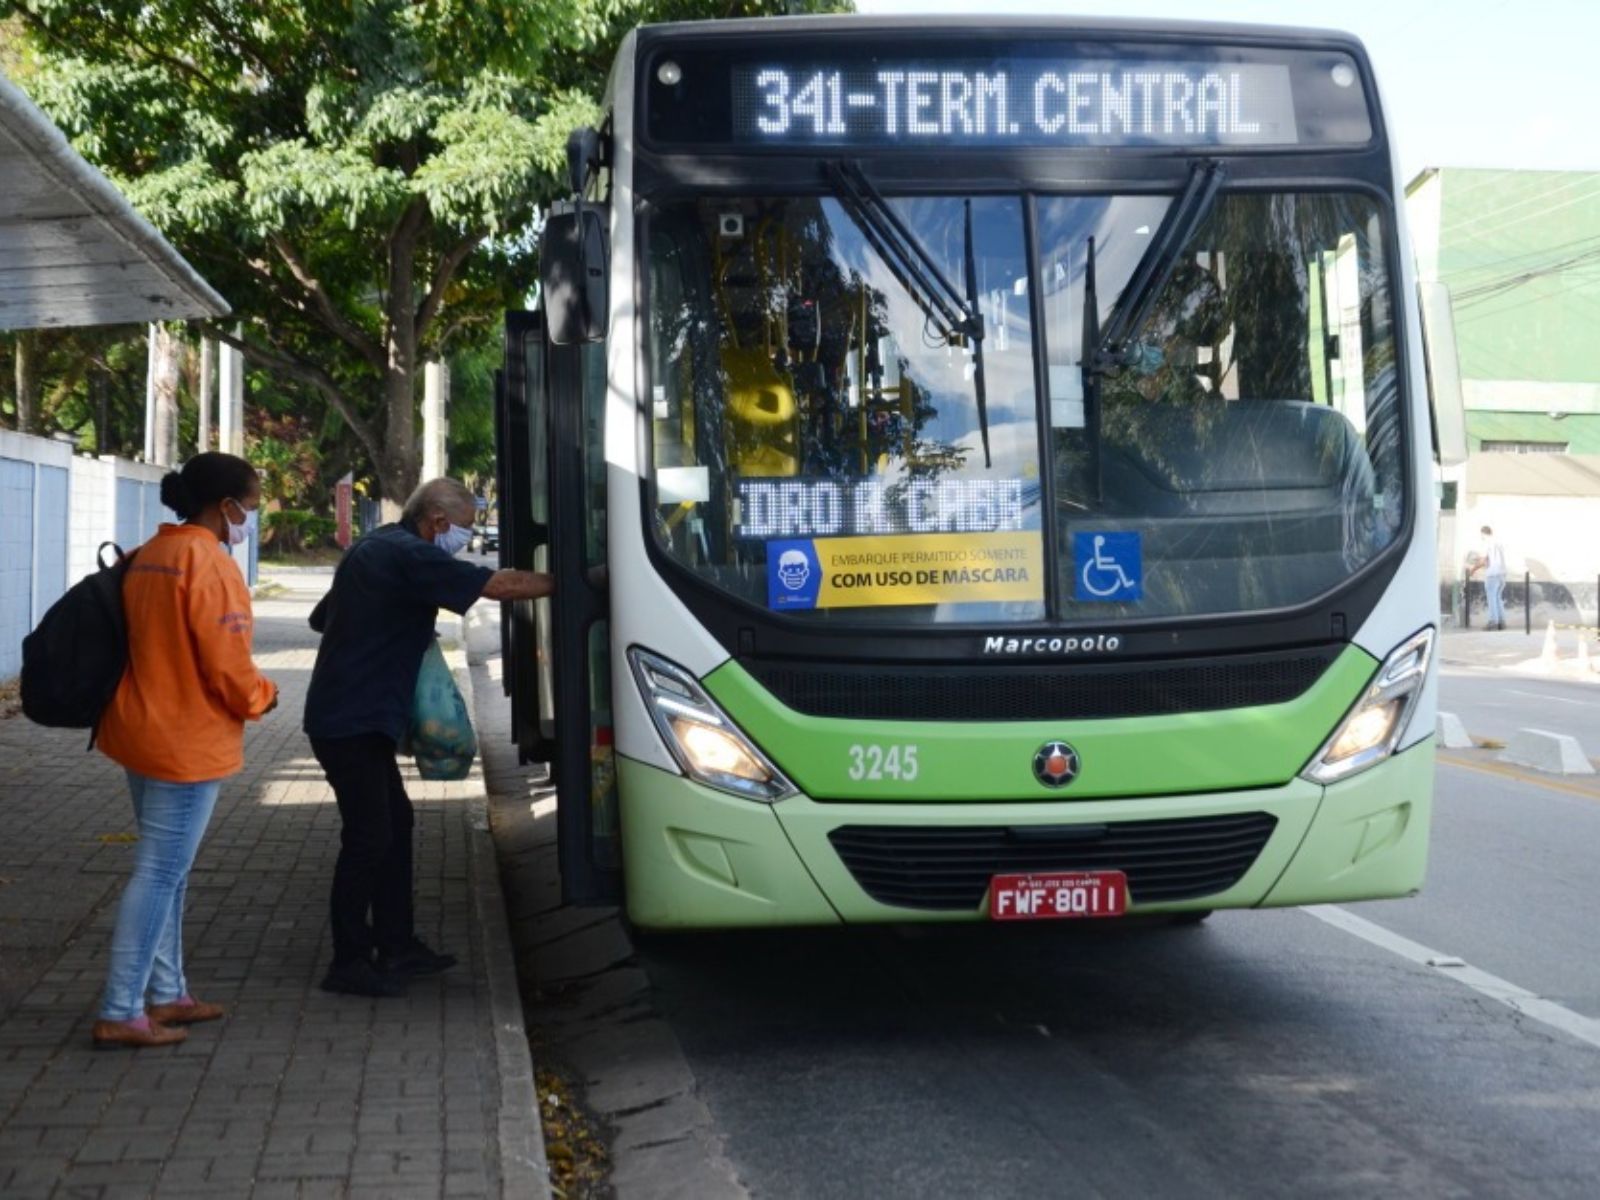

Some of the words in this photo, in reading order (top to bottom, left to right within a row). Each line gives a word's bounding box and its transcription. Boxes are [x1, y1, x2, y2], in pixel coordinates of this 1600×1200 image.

[1034, 71, 1260, 135] CENTRAL
[831, 552, 899, 567] EMBARQUE
[902, 550, 966, 564] PERMITIDO
[970, 547, 1028, 562] SOMENTE
[831, 571, 872, 588] COM
[875, 570, 913, 587] USO
[916, 569, 939, 585] DE
[943, 566, 1029, 585] MÁSCARA
[983, 635, 1120, 654] Marcopolo
[849, 744, 918, 781] 3245
